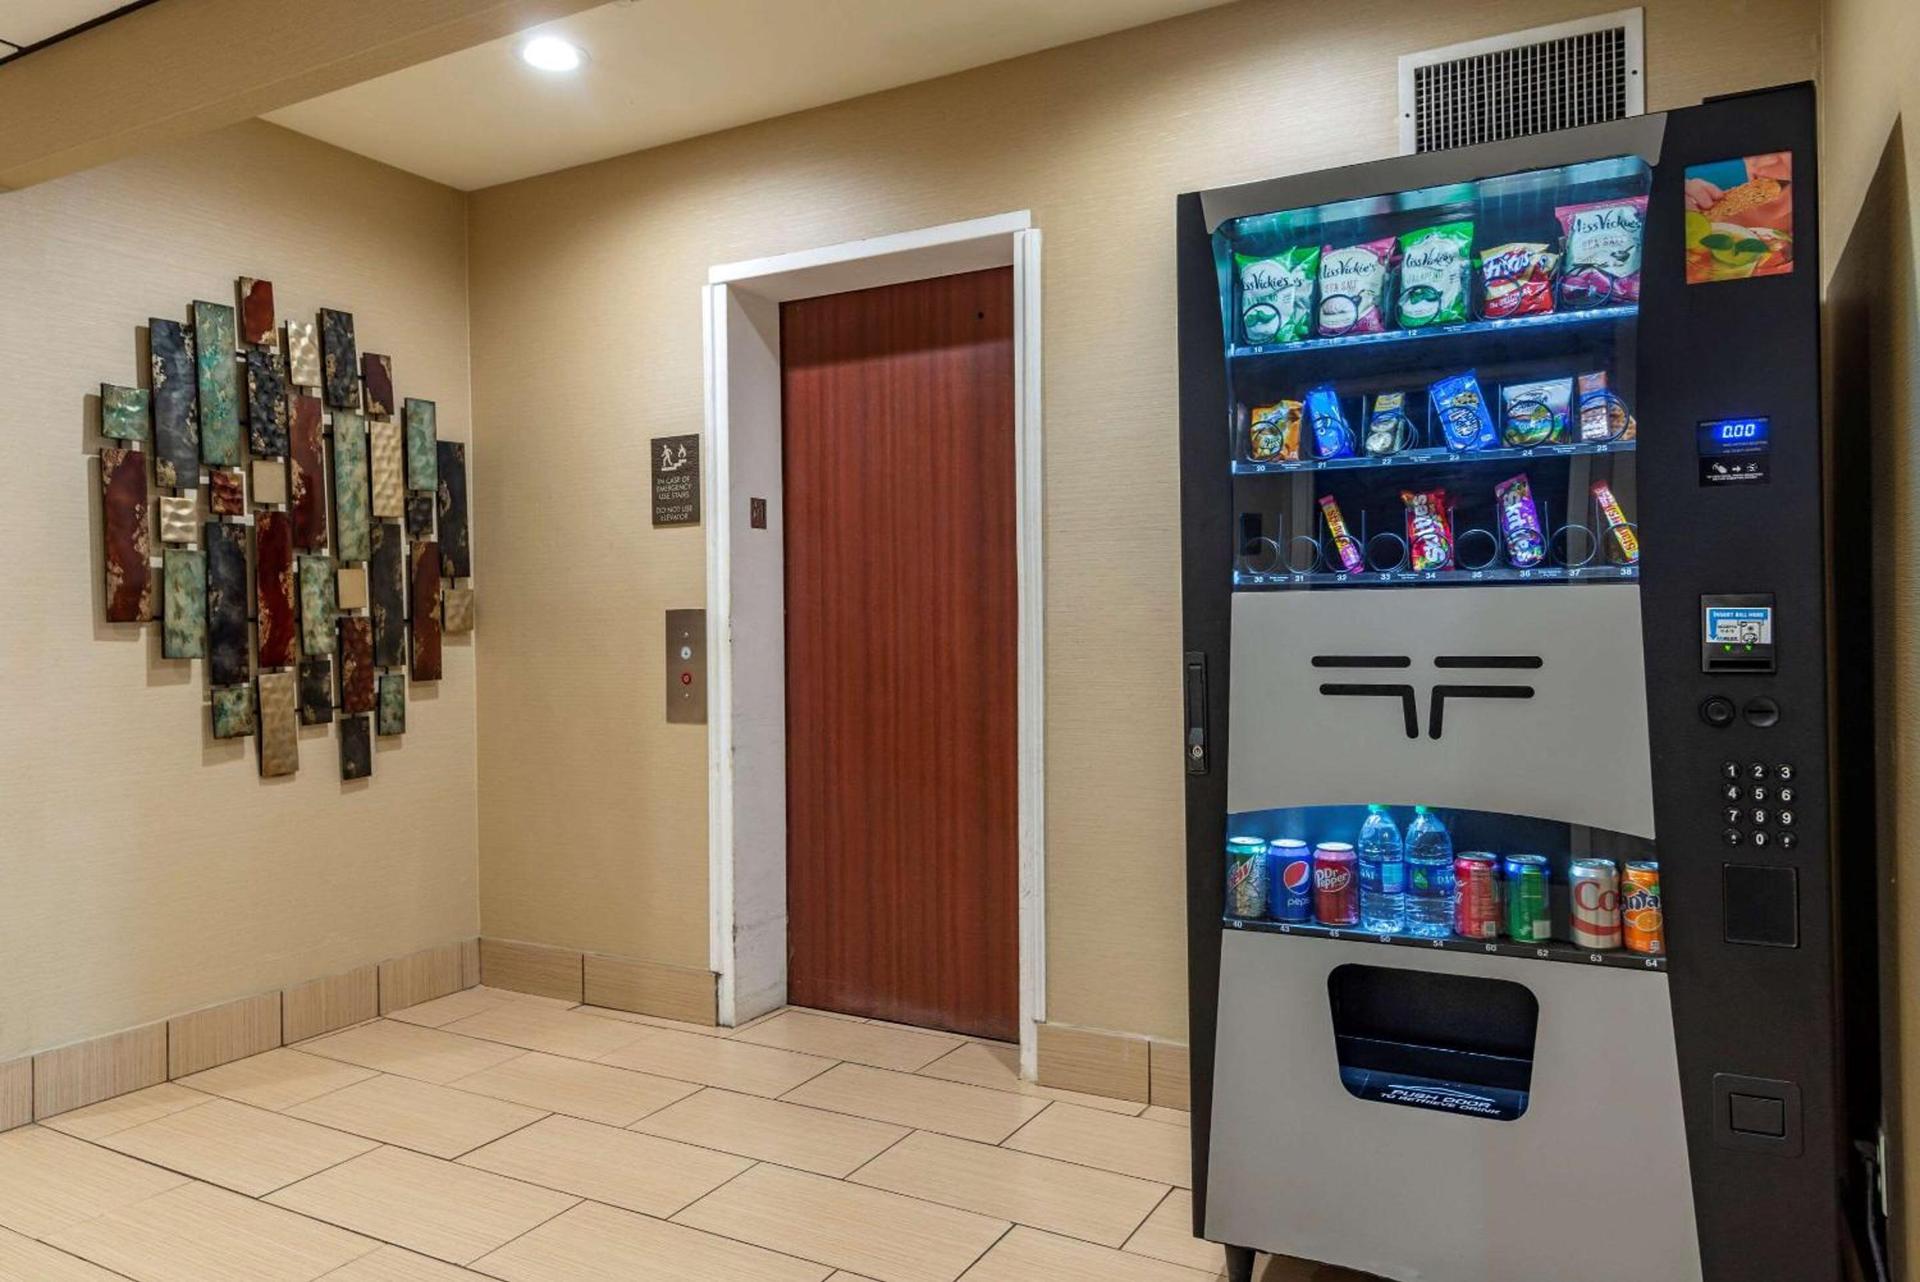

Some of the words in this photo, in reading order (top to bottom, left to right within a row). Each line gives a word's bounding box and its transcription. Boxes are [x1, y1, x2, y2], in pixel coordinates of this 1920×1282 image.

[1722, 423, 1756, 438] 0.00
[1522, 449, 1533, 457] 24
[1519, 570, 1531, 578] 36
[1620, 568, 1632, 576] 38
[1728, 764, 1735, 777] 1
[1754, 765, 1763, 777] 2
[1781, 766, 1790, 778] 3
[1728, 787, 1736, 799] 4
[1755, 788, 1763, 800] 5
[1781, 788, 1791, 801] 6
[1729, 810, 1738, 822] 7
[1755, 810, 1764, 823] 8
[1782, 812, 1791, 824] 9
[1755, 833, 1764, 845] 0
[1323, 867, 1338, 878] Dr
[1316, 869, 1348, 889] Pepper
[1537, 949, 1549, 957] 62
[1590, 954, 1602, 962] 63
[1646, 959, 1658, 967] 64
[1391, 1089, 1439, 1100] PUSH
[1443, 1097, 1491, 1108] DOOR
[1459, 1105, 1502, 1114] DRINK
